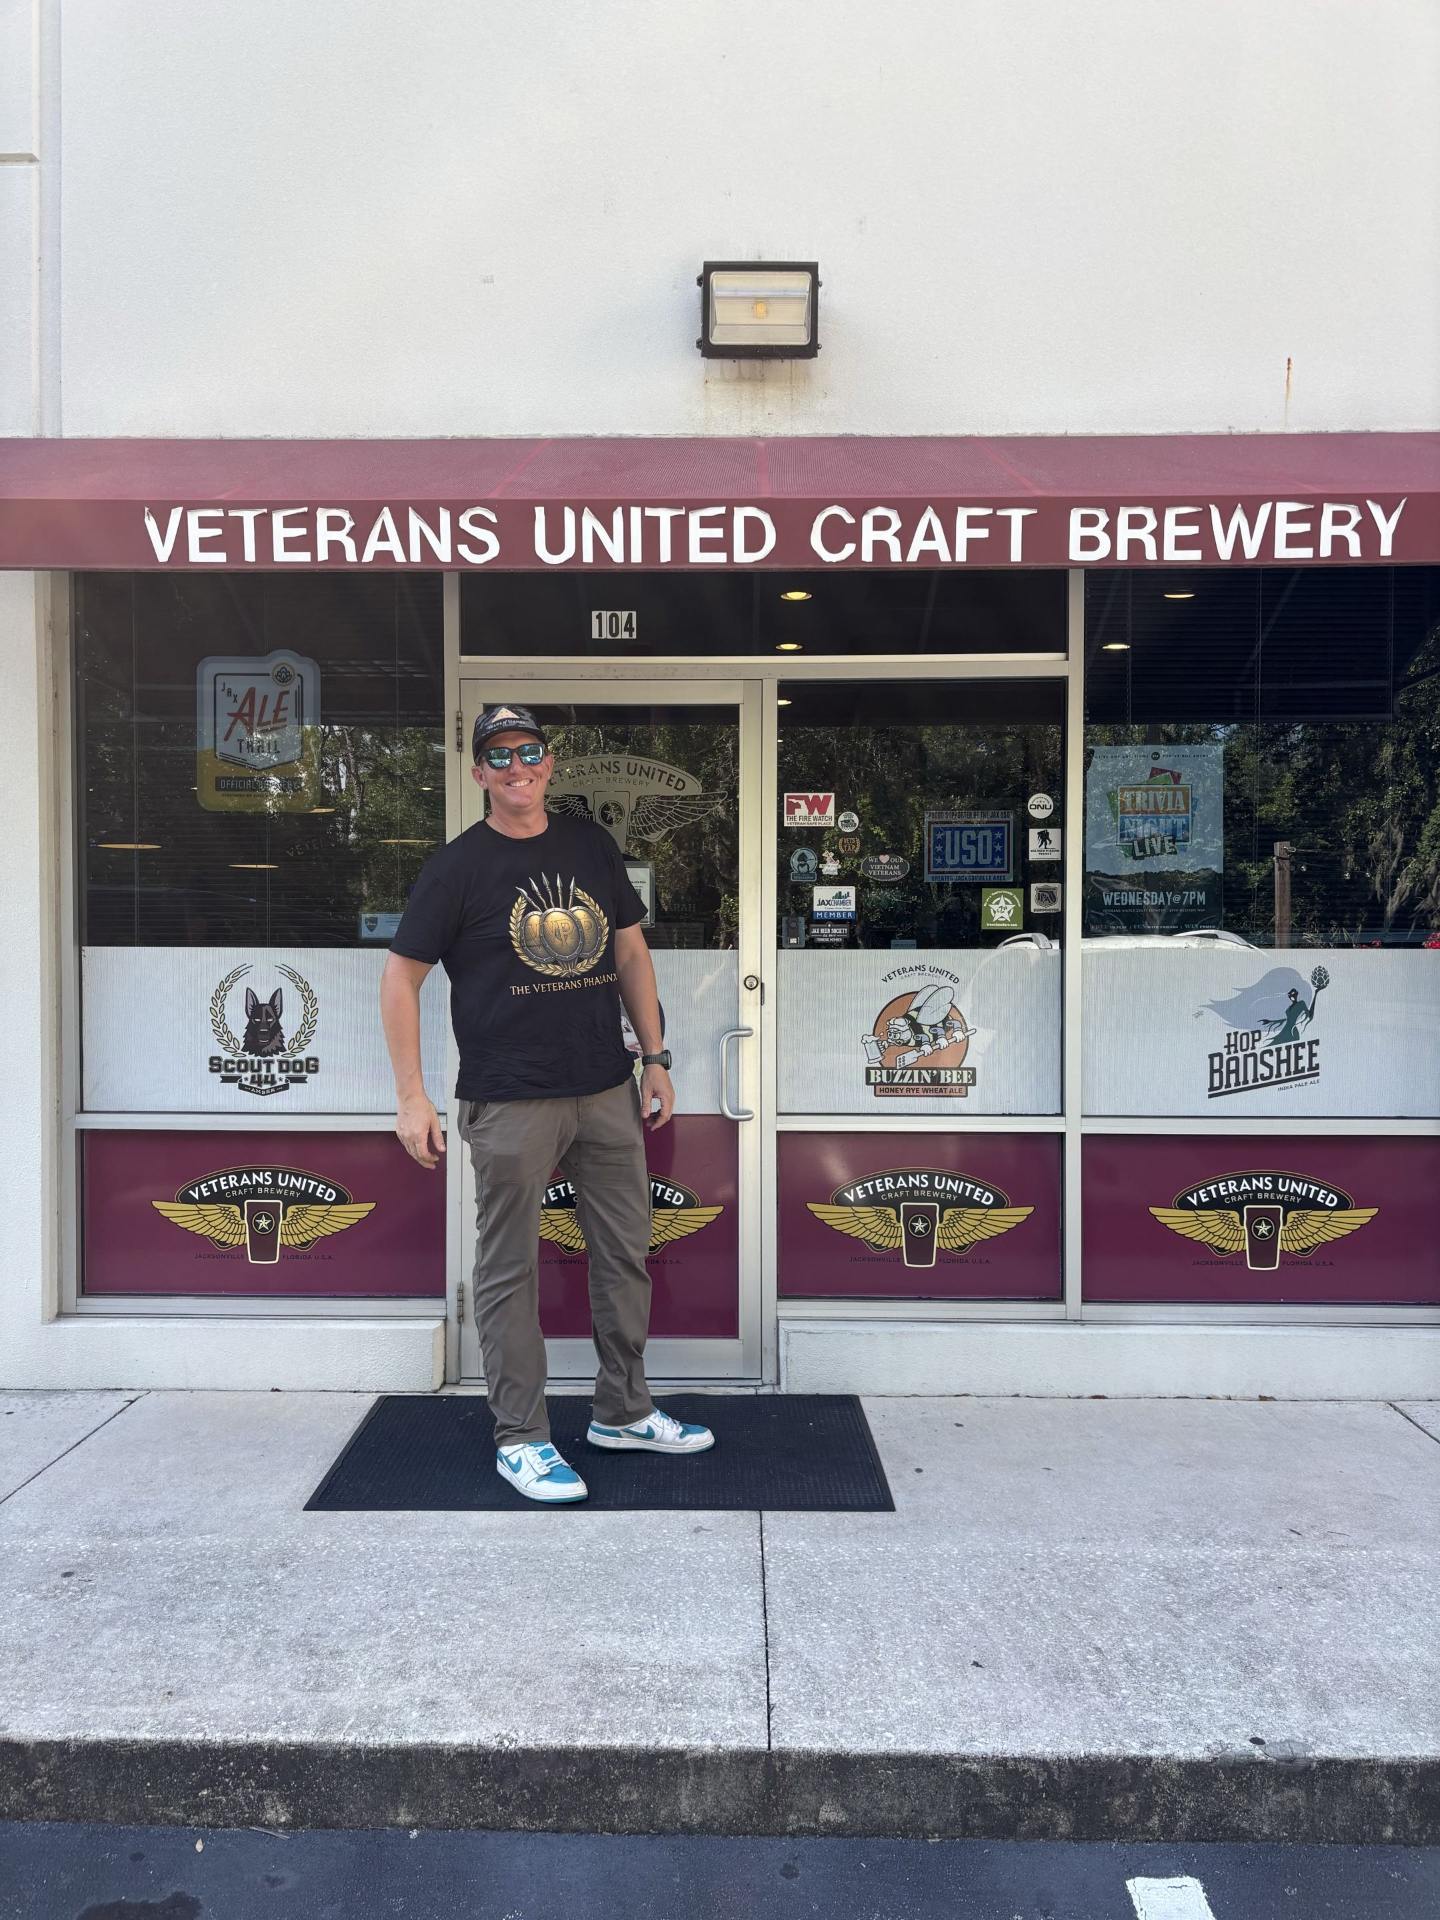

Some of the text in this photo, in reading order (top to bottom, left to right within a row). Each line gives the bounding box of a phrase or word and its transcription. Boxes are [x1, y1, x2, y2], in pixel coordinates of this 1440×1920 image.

[144, 497, 1408, 565] VETERANS UNITED CRAFT BREWERY
[595, 611, 635, 638] 104
[221, 682, 239, 704] JAX
[224, 687, 290, 741] ALE
[220, 779, 256, 789] OFFICIAL
[549, 760, 687, 792] ETERANS UNITED
[605, 776, 651, 788] BREWERY
[786, 795, 833, 815] FW
[1125, 790, 1185, 811] TRIVIA
[1124, 818, 1187, 840] NIGHT
[945, 830, 993, 865] USO
[1133, 835, 1176, 857] LIVE
[881, 964, 960, 984] VETERANS UNITED
[509, 984, 531, 996] THE
[532, 979, 582, 993] VETERANS
[1223, 1029, 1262, 1055] HOP
[209, 1055, 320, 1074] SCOUT DOG
[1207, 1039, 1320, 1093] BANSHEE
[249, 1073, 277, 1088] 44
[939, 1069, 973, 1084] BEE
[1277, 1084, 1294, 1092] INDIA
[1294, 1081, 1308, 1089] PALE
[250, 1087, 276, 1095] AMBER
[188, 1171, 337, 1202] VETERANS UNITED
[225, 1187, 301, 1198] CRAFT BREWERY
[649, 1182, 685, 1206] ITED
[844, 1174, 995, 1206] VETERANS UNITED
[880, 1189, 958, 1201] CRAFT BREWERY
[1187, 1176, 1339, 1208] VETERANS UNITED
[1224, 1192, 1302, 1204] CRAFT BREWERY
